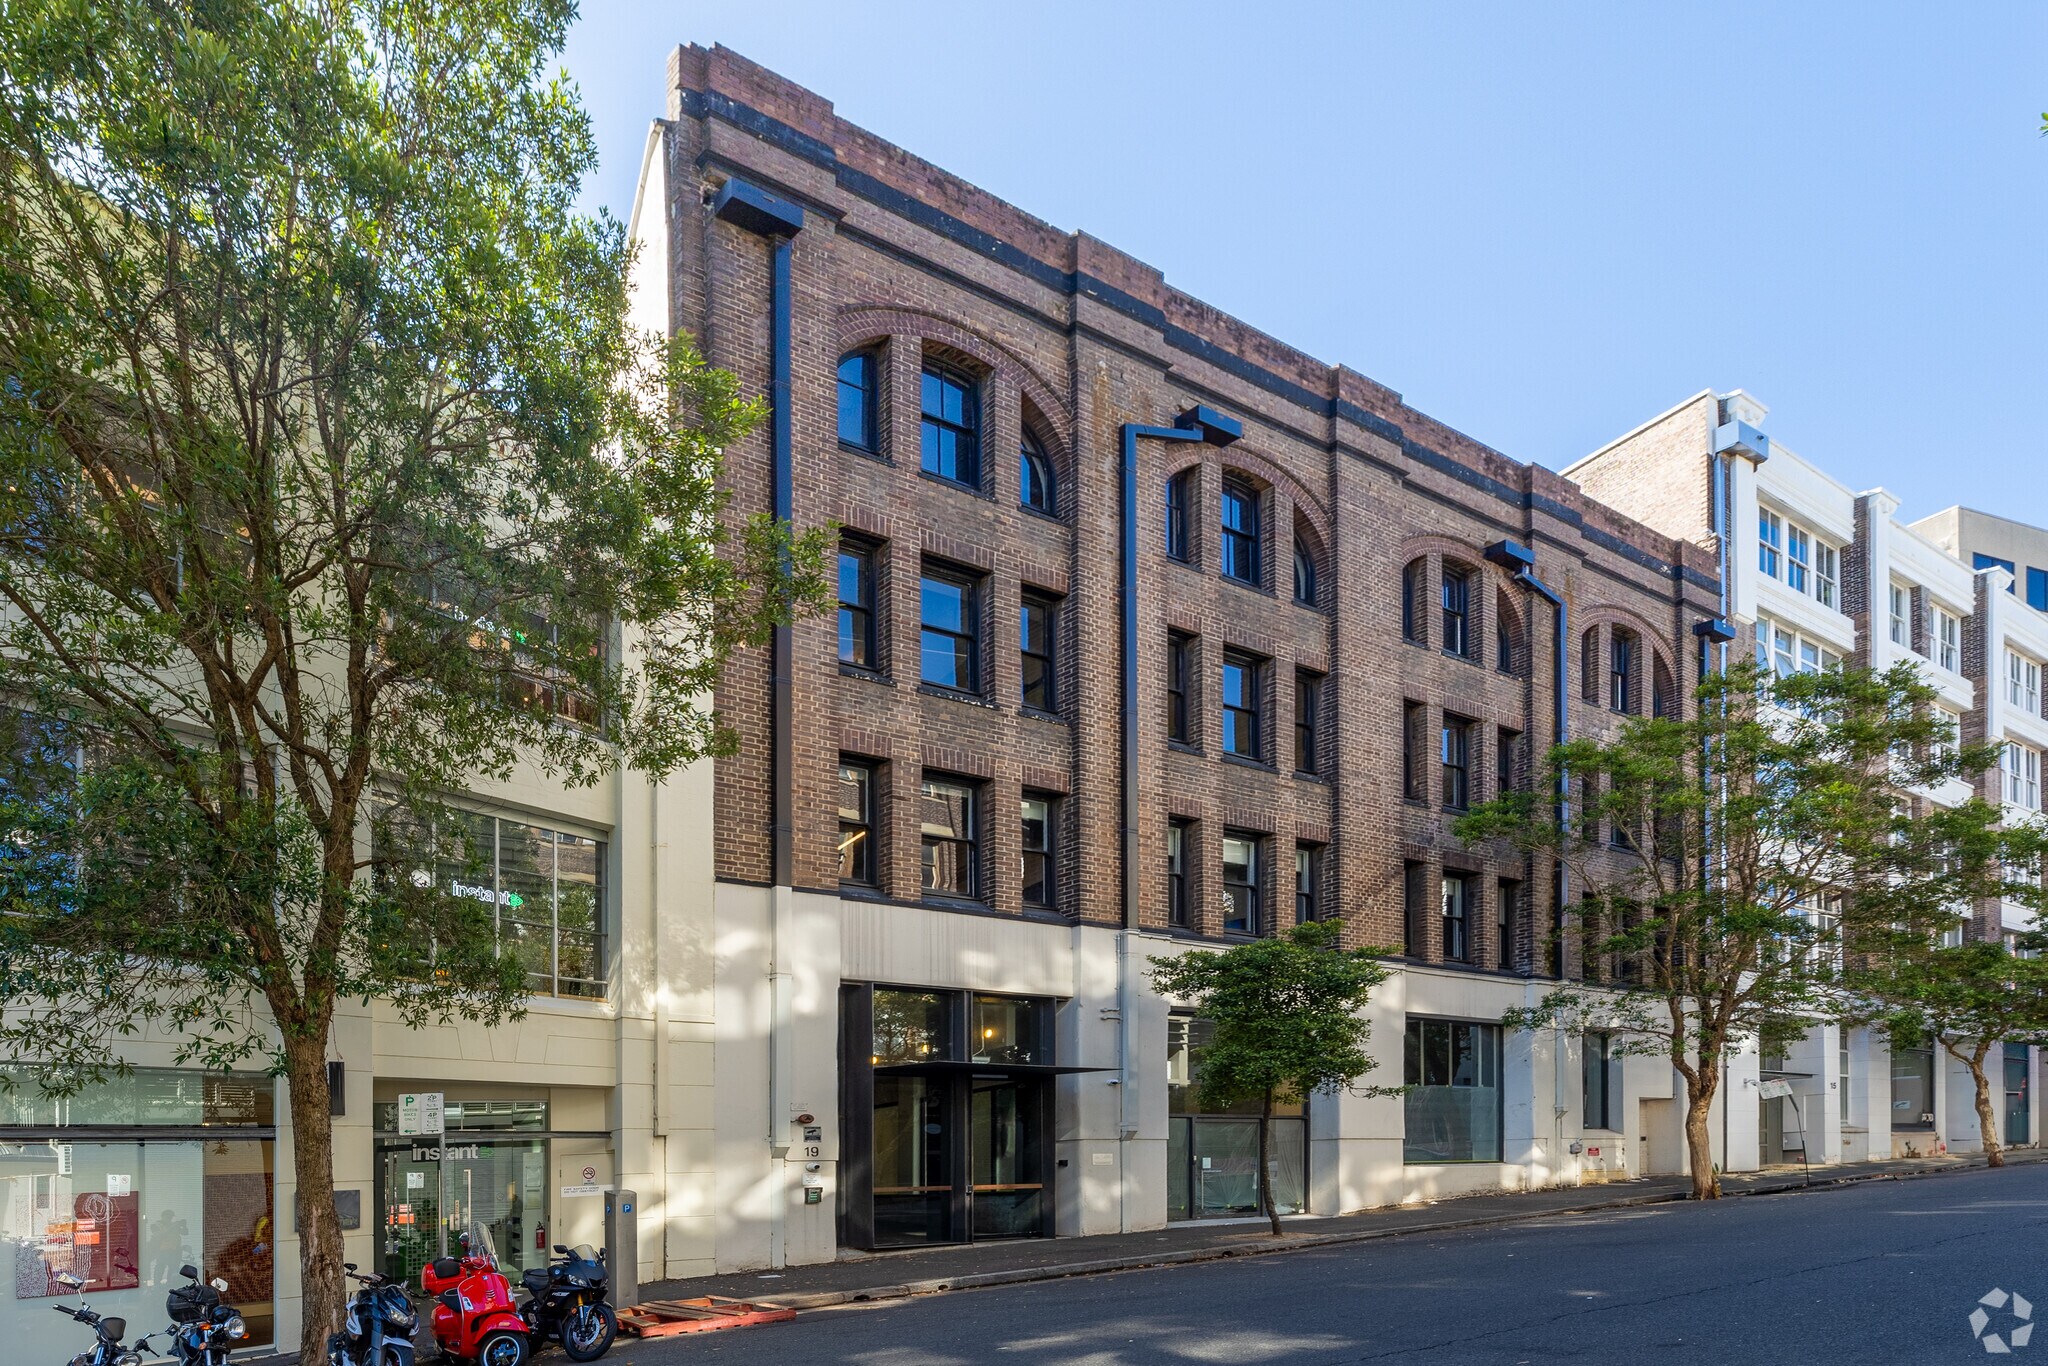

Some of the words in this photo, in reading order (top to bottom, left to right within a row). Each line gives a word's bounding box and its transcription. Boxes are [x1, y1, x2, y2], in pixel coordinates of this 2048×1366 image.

[405, 1096, 414, 1106] P
[804, 1146, 819, 1158] 19
[624, 1205, 630, 1213] P
